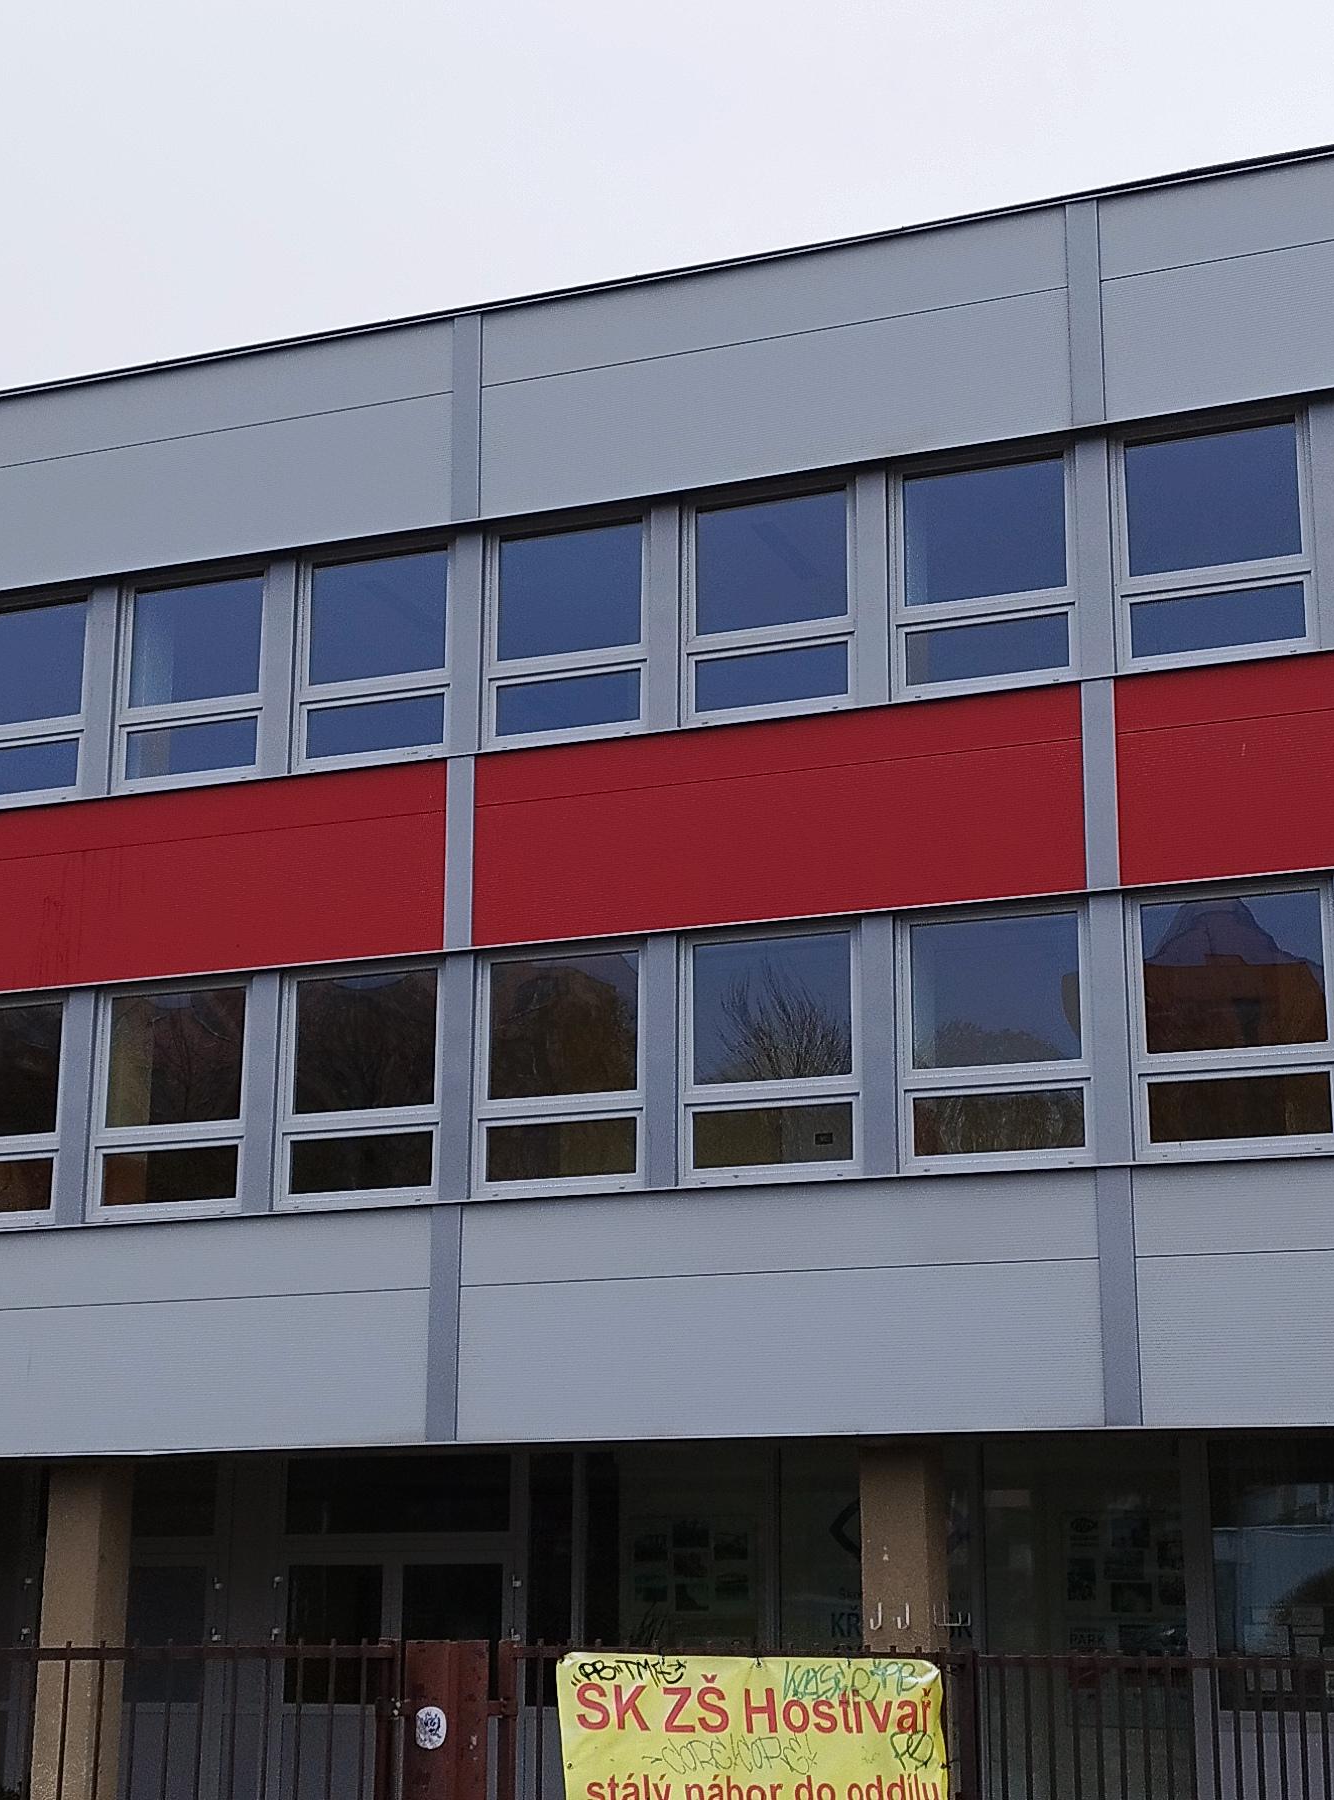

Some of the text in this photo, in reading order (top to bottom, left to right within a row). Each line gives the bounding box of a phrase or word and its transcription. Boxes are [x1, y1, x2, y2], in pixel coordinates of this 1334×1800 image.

[576, 1674, 932, 1735] SK ZŠ Hostivař
[684, 1774, 784, 1800] nábor
[794, 1775, 837, 1800] do
[847, 1773, 940, 1800] oddílu
